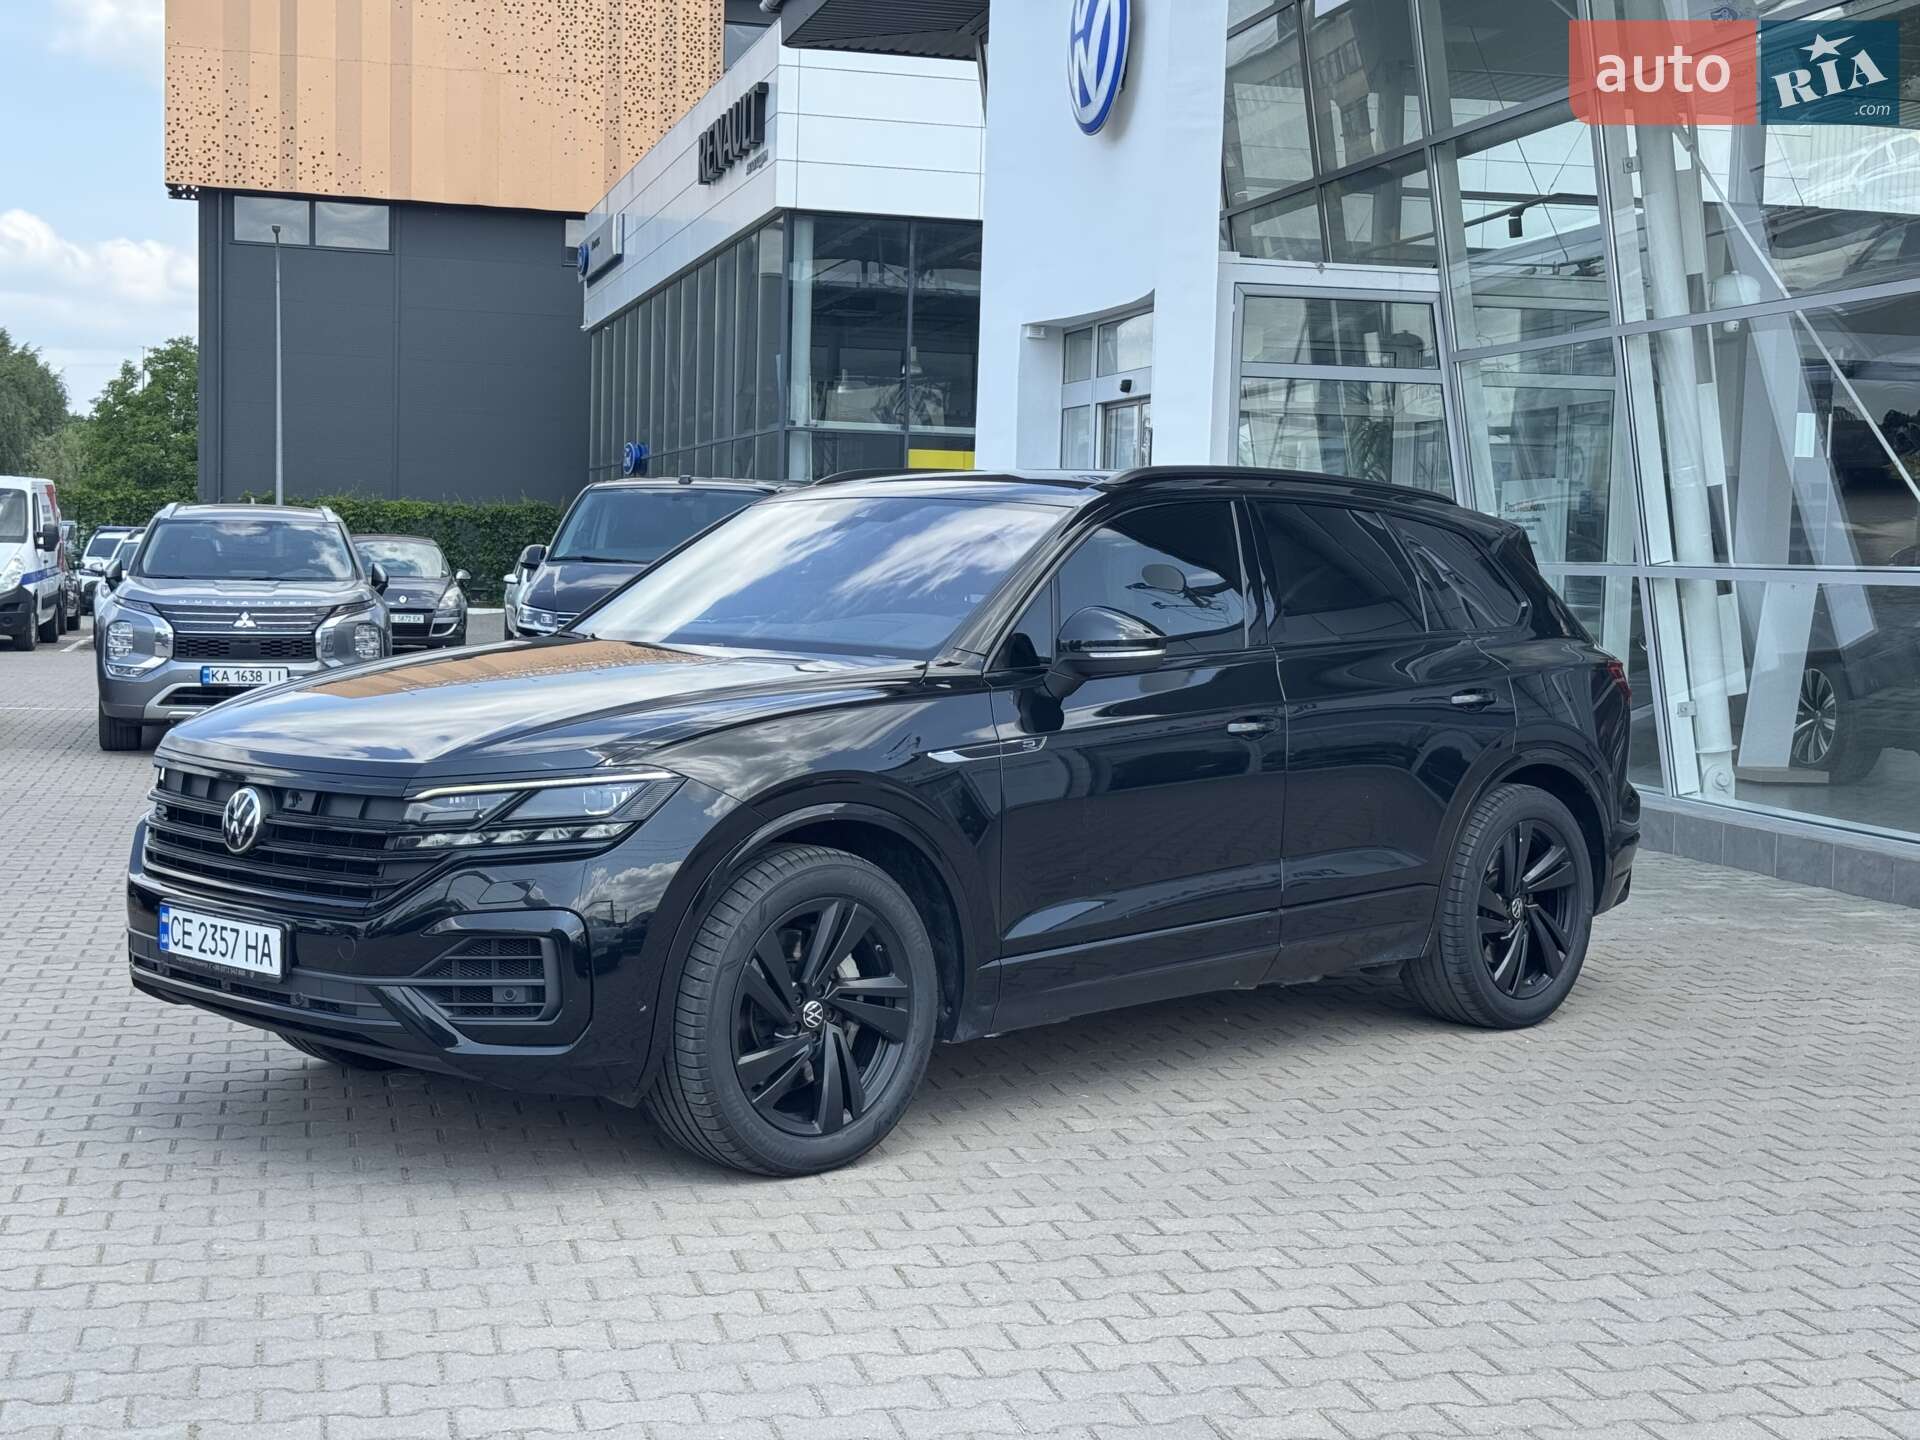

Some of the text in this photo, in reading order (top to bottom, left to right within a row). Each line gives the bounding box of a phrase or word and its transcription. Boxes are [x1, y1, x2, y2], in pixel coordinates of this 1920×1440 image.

[698, 81, 769, 185] RENAULT
[211, 670, 230, 682] KA
[236, 670, 263, 682] 1638
[170, 914, 194, 951] CE
[198, 921, 241, 960] 2357
[245, 929, 274, 968] HA
